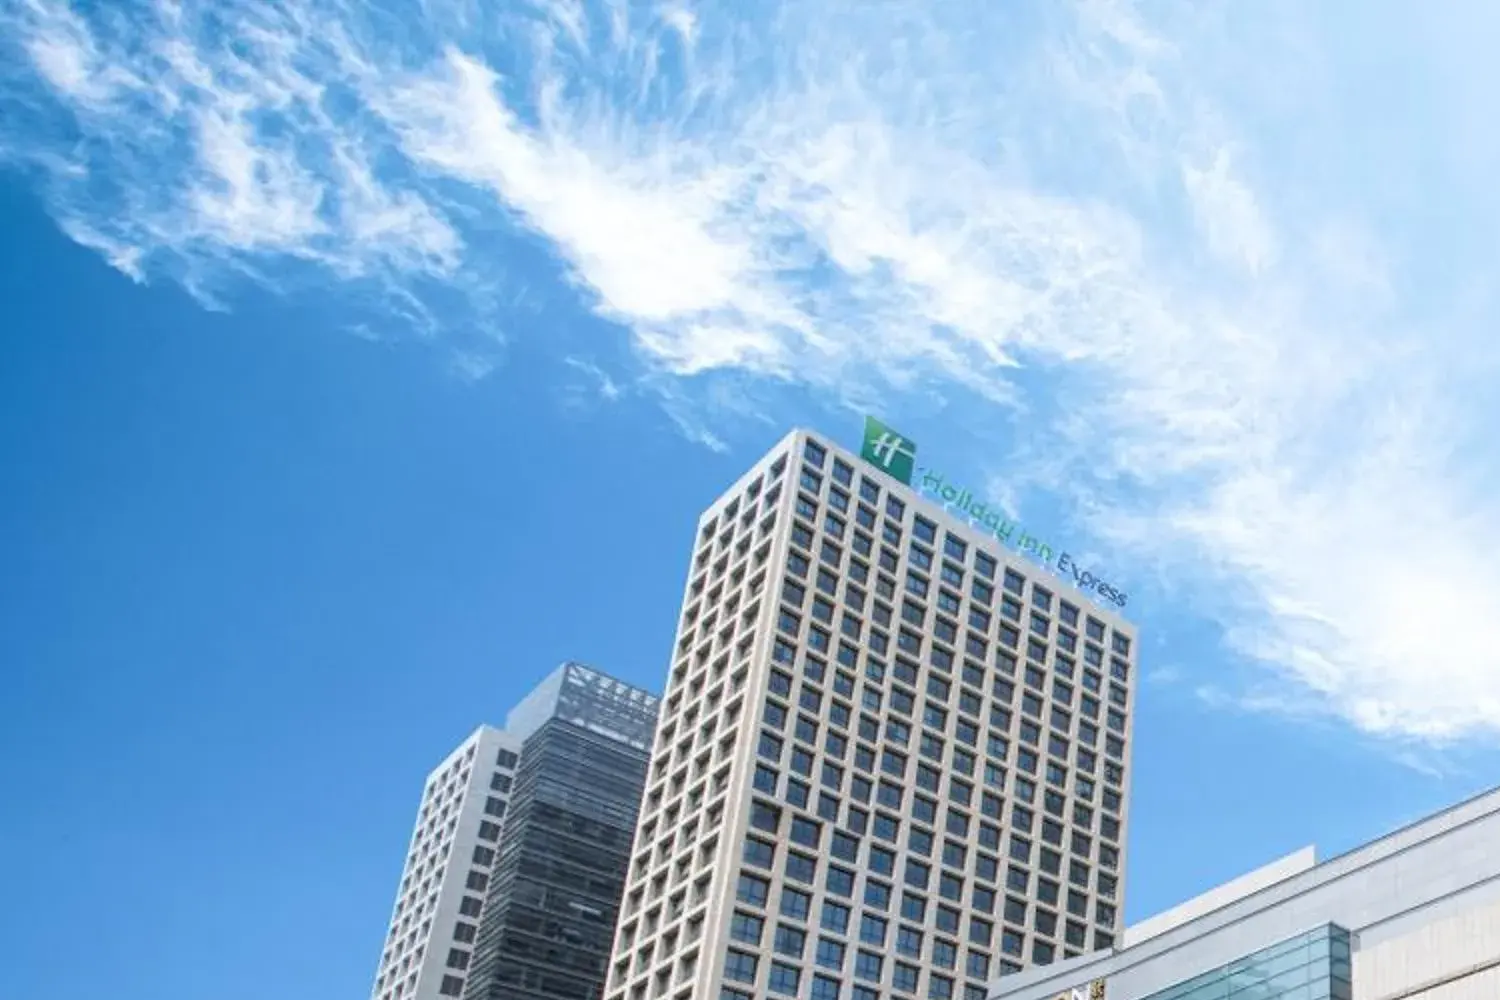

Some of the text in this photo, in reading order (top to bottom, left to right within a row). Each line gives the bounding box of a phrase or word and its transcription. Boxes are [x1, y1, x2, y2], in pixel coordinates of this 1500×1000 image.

[922, 468, 1128, 608] Holiday Inn Express
